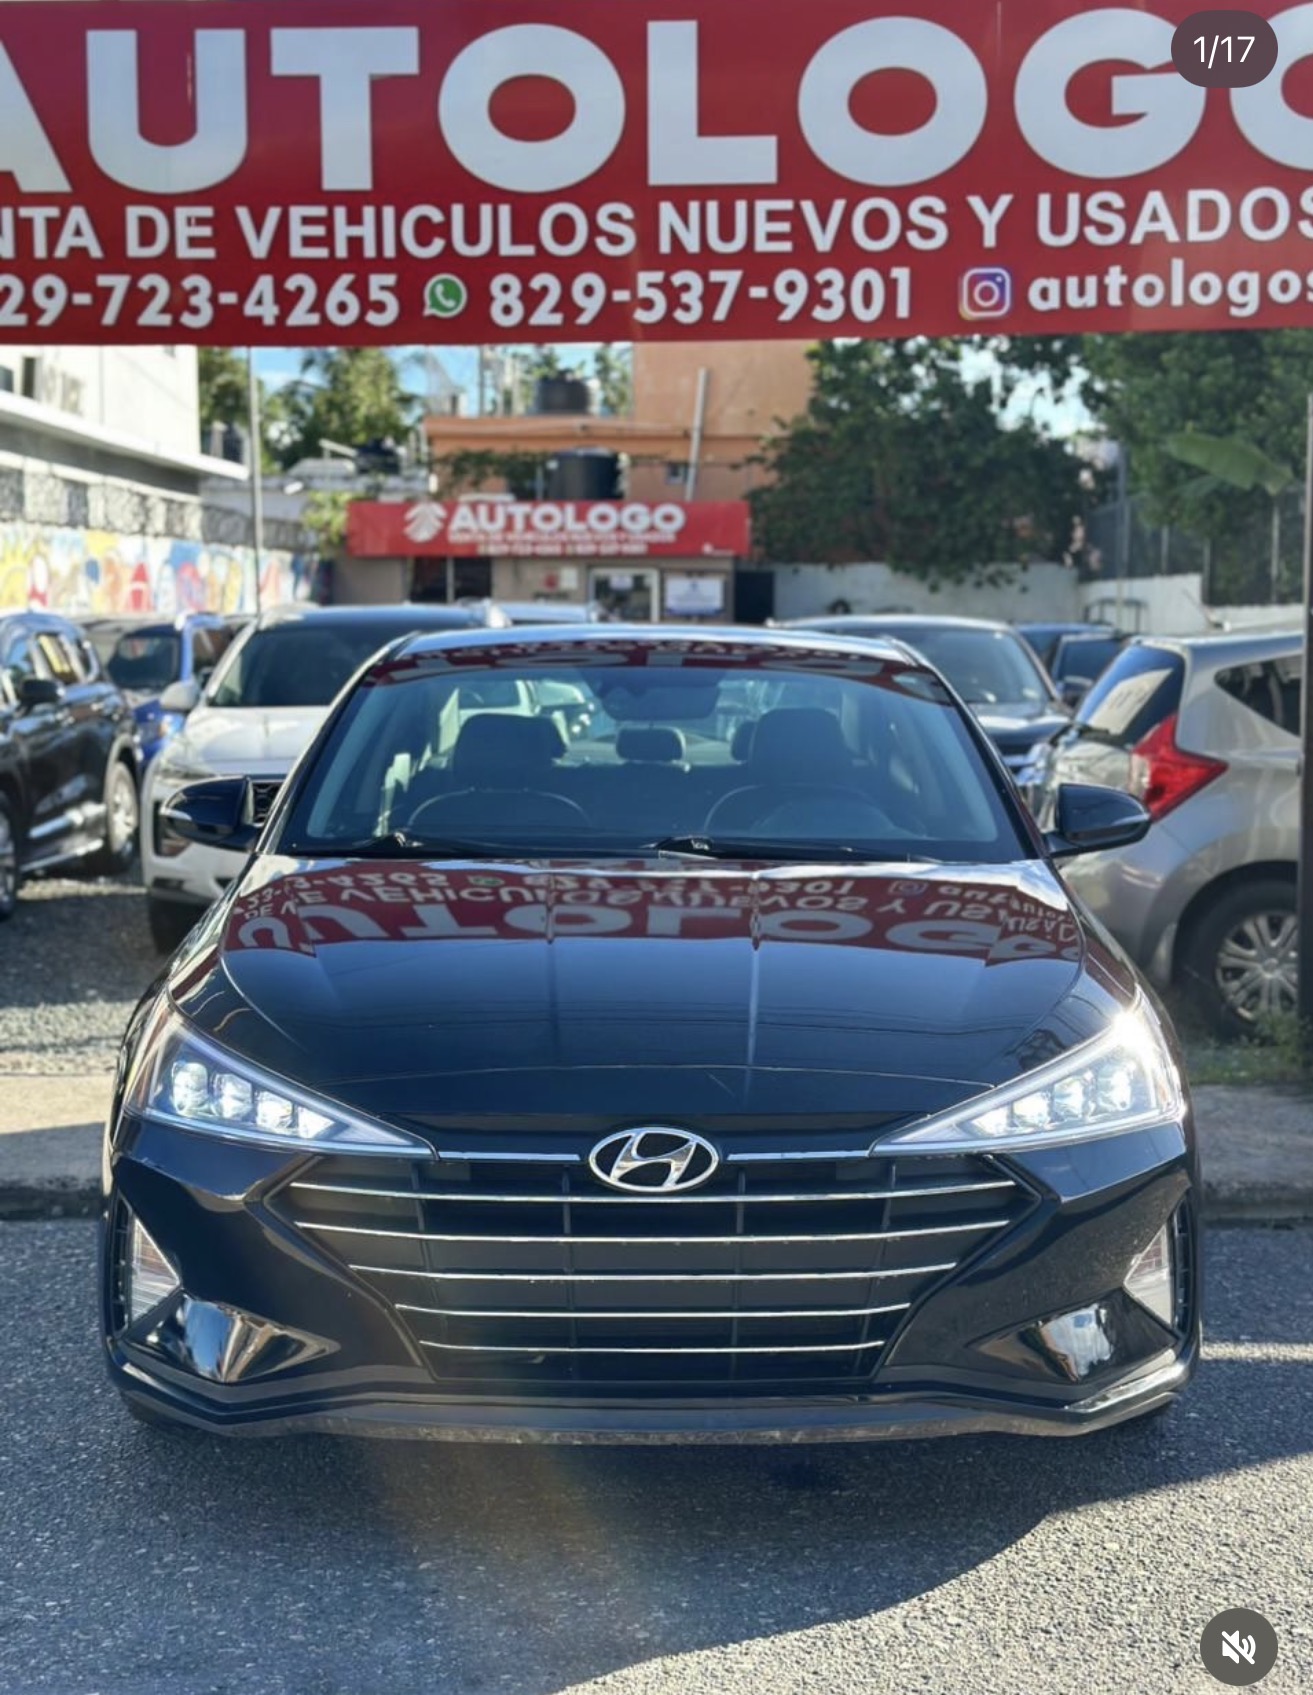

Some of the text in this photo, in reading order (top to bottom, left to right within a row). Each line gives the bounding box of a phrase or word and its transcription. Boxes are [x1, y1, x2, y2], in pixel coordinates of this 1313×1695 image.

[126, 205, 216, 259] DE
[235, 202, 637, 259] VEHICULOS
[659, 197, 949, 255] NUEVOS
[966, 193, 1014, 248] Y
[490, 266, 911, 327] 829-537-9301
[448, 503, 685, 534] AUTOLOGO
